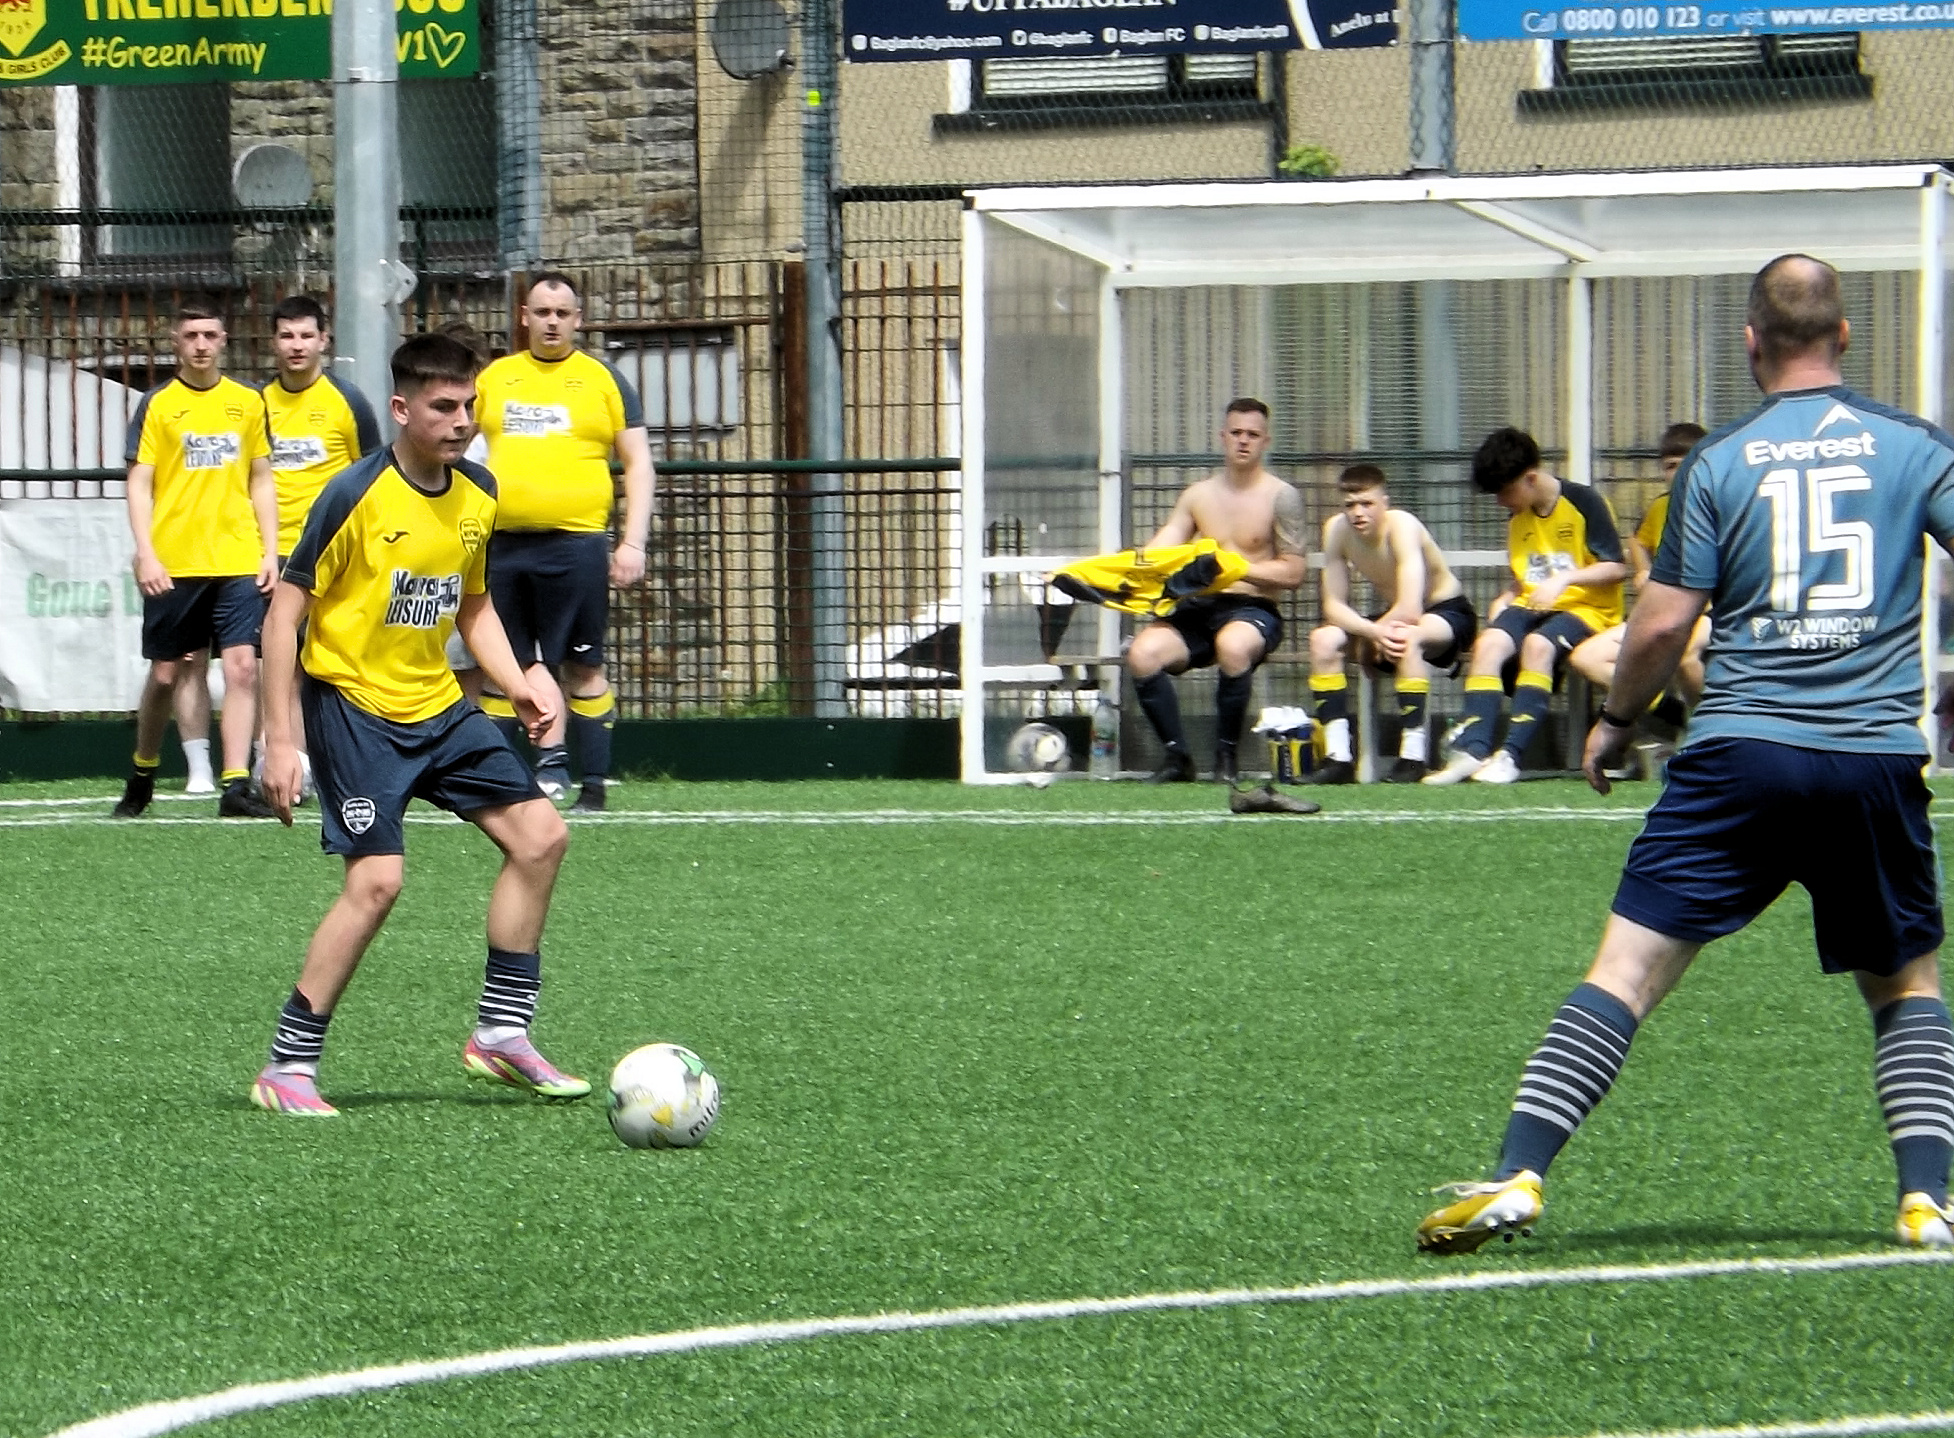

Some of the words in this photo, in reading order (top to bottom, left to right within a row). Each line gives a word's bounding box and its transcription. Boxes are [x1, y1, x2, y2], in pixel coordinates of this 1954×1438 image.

[1523, 12, 1557, 32] Call
[1562, 9, 1616, 30] 0800
[1620, 8, 1659, 29] 010
[1666, 6, 1700, 28] 123
[1706, 13, 1729, 27] or
[1165, 27, 1186, 42] FC
[81, 36, 266, 74] #GreenArmy
[1744, 432, 1876, 466] Everest
[1758, 464, 1874, 613] 15
[1803, 615, 1878, 634] WINDOW
